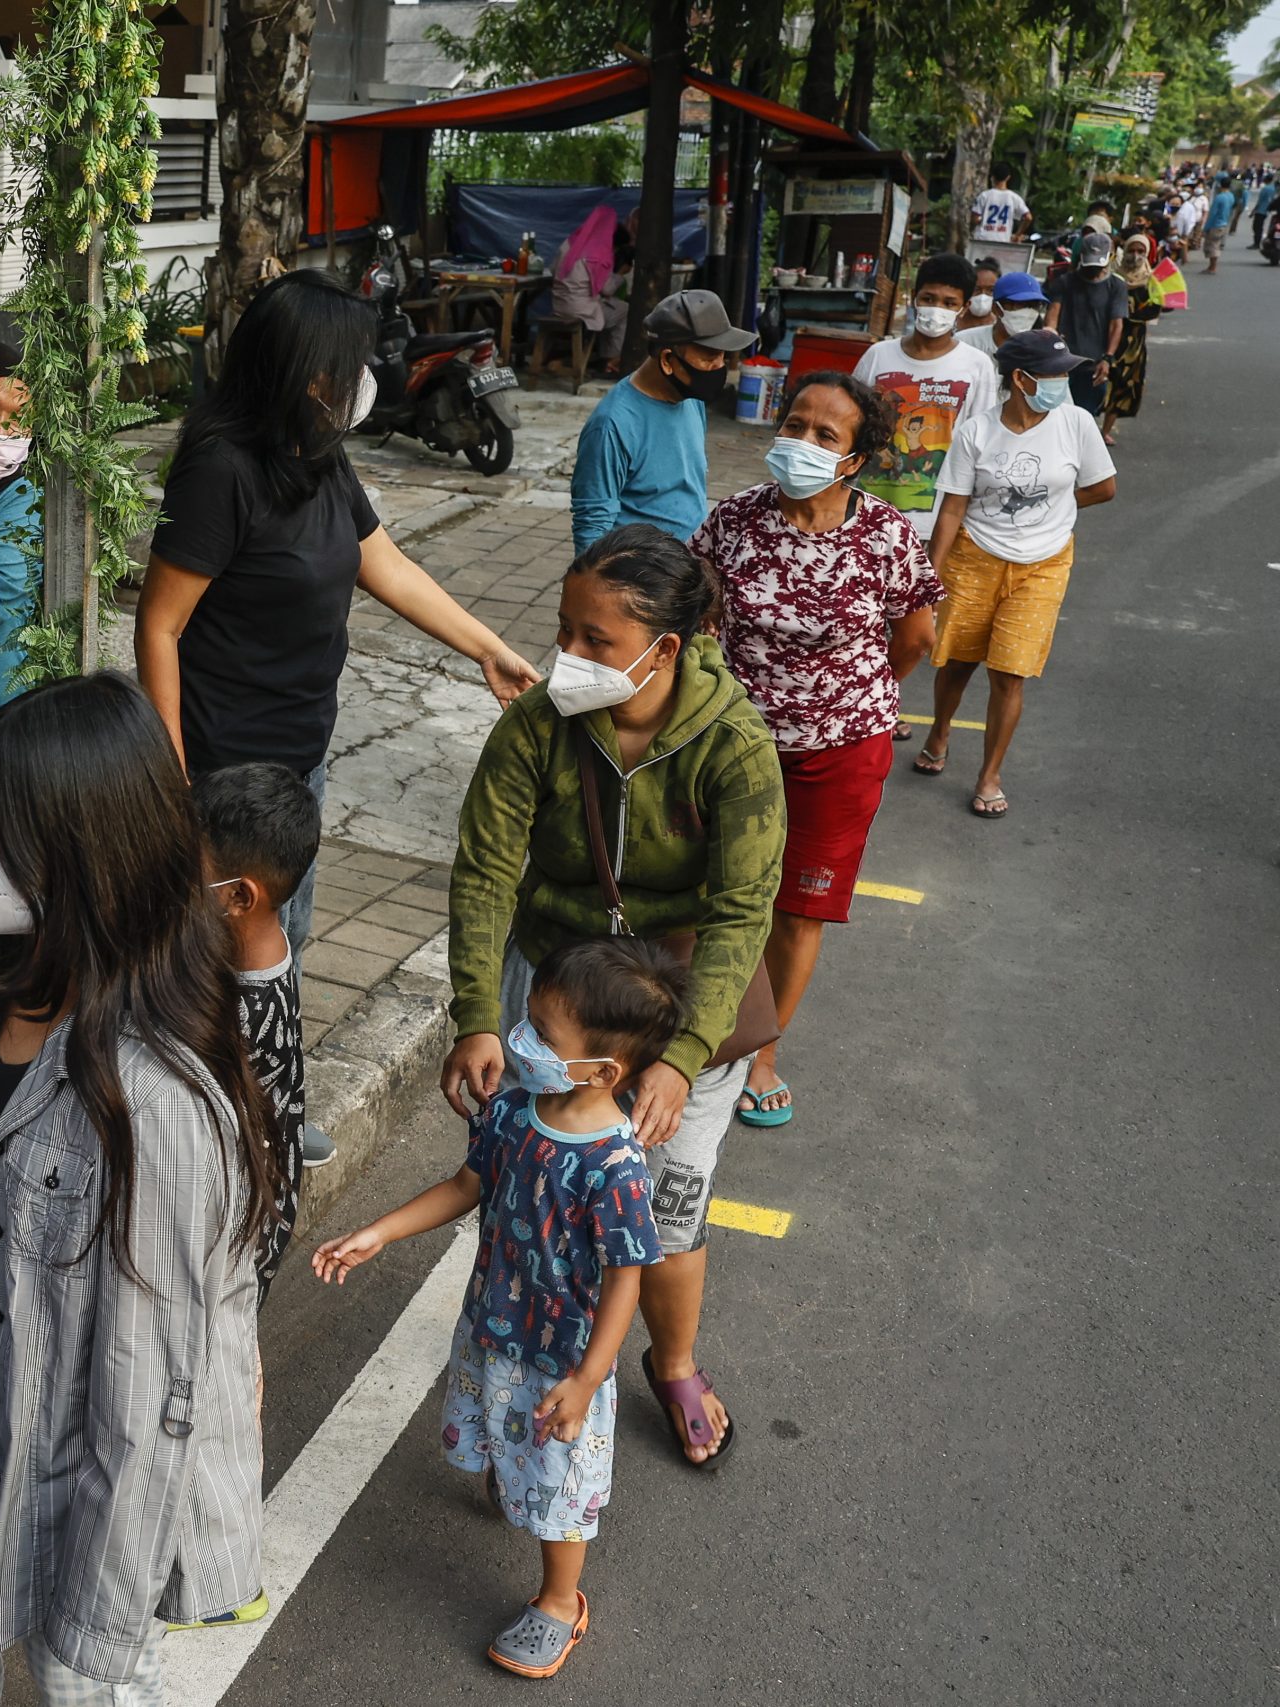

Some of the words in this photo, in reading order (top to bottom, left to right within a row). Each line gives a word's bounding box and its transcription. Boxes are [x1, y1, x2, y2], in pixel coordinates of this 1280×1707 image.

[986, 204, 1010, 225] 24
[919, 383, 951, 394] Beripat
[919, 392, 960, 407] Beregong
[651, 1167, 706, 1218] 52
